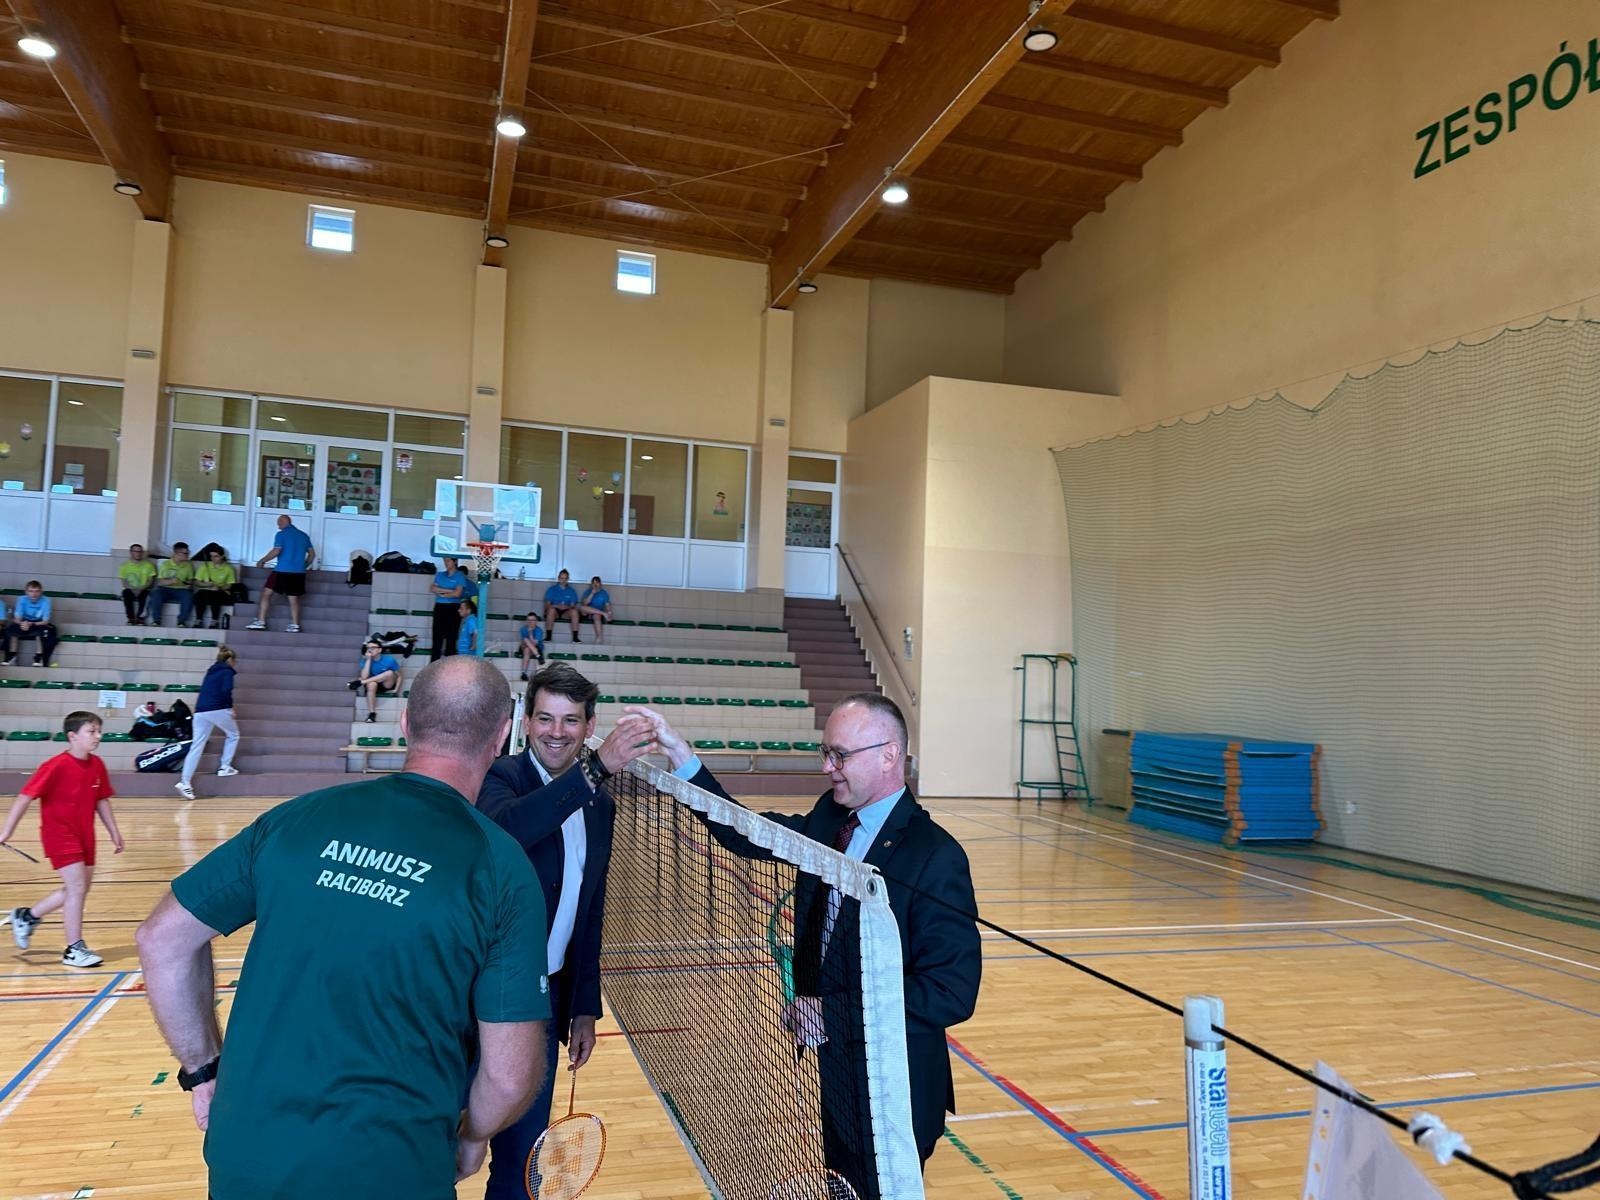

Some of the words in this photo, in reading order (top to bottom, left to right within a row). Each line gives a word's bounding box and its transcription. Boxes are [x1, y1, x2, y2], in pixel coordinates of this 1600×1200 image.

[1413, 38, 1600, 180] ZESPÓŁ
[319, 839, 433, 884] ANIMUSZ
[315, 869, 411, 908] RACIBÓRZ
